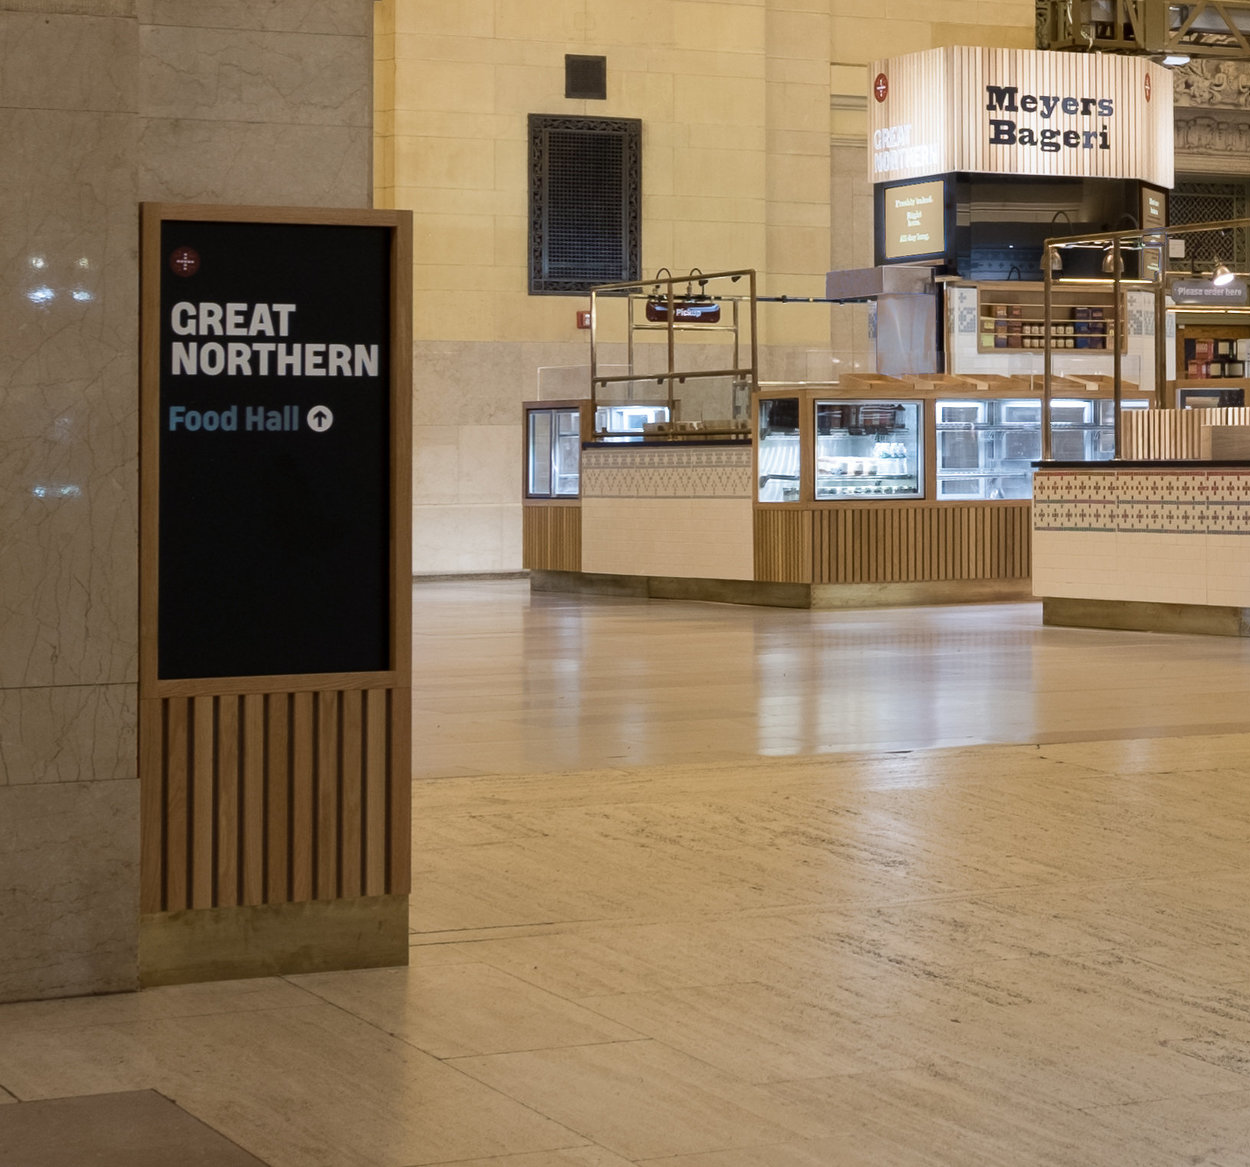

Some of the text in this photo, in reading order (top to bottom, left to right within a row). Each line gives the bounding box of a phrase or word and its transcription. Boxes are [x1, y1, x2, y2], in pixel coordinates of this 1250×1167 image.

[986, 86, 1113, 119] Meyers
[989, 119, 1111, 152] Bageri
[1178, 286, 1242, 296] Please order here
[171, 302, 297, 336] GREAT
[676, 308, 702, 318] Pickup
[171, 342, 379, 377] NORTHERN
[169, 405, 300, 431] Food Hall
